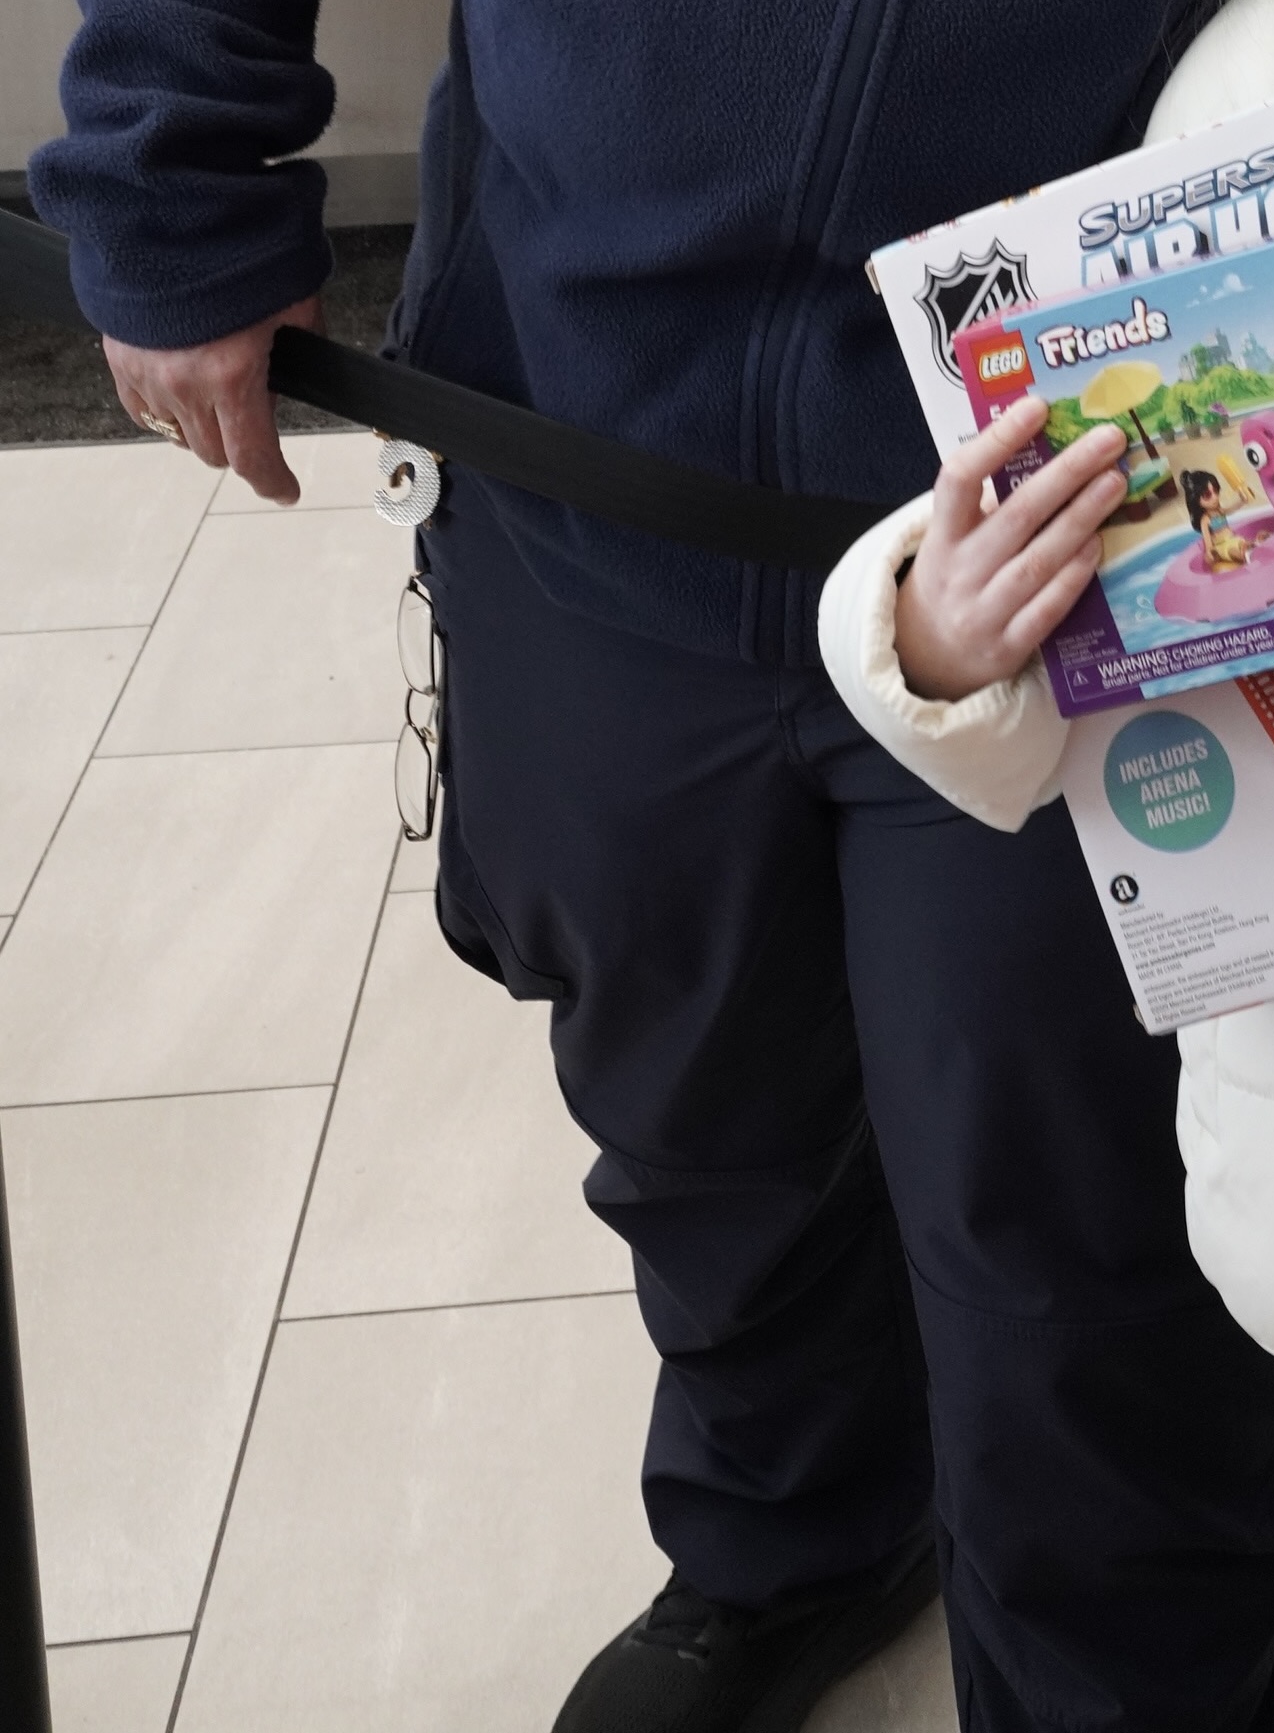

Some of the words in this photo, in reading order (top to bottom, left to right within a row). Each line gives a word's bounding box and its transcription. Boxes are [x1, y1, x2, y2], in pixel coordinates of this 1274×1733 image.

[1036, 297, 1172, 368] Friends
[980, 347, 1025, 380] LEGO
[1097, 649, 1172, 677] WARNING:
[1171, 638, 1223, 660] CHOKING
[1223, 625, 1271, 646] HAZARD.
[1102, 676, 1126, 688] Small
[1152, 665, 1168, 676] Not
[1169, 661, 1182, 671] for
[1183, 652, 1219, 668] children
[1220, 646, 1247, 658] under
[1119, 738, 1208, 784] INCLUDES
[1140, 767, 1201, 804] ARENA
[1145, 792, 1211, 829] MUSIC!
